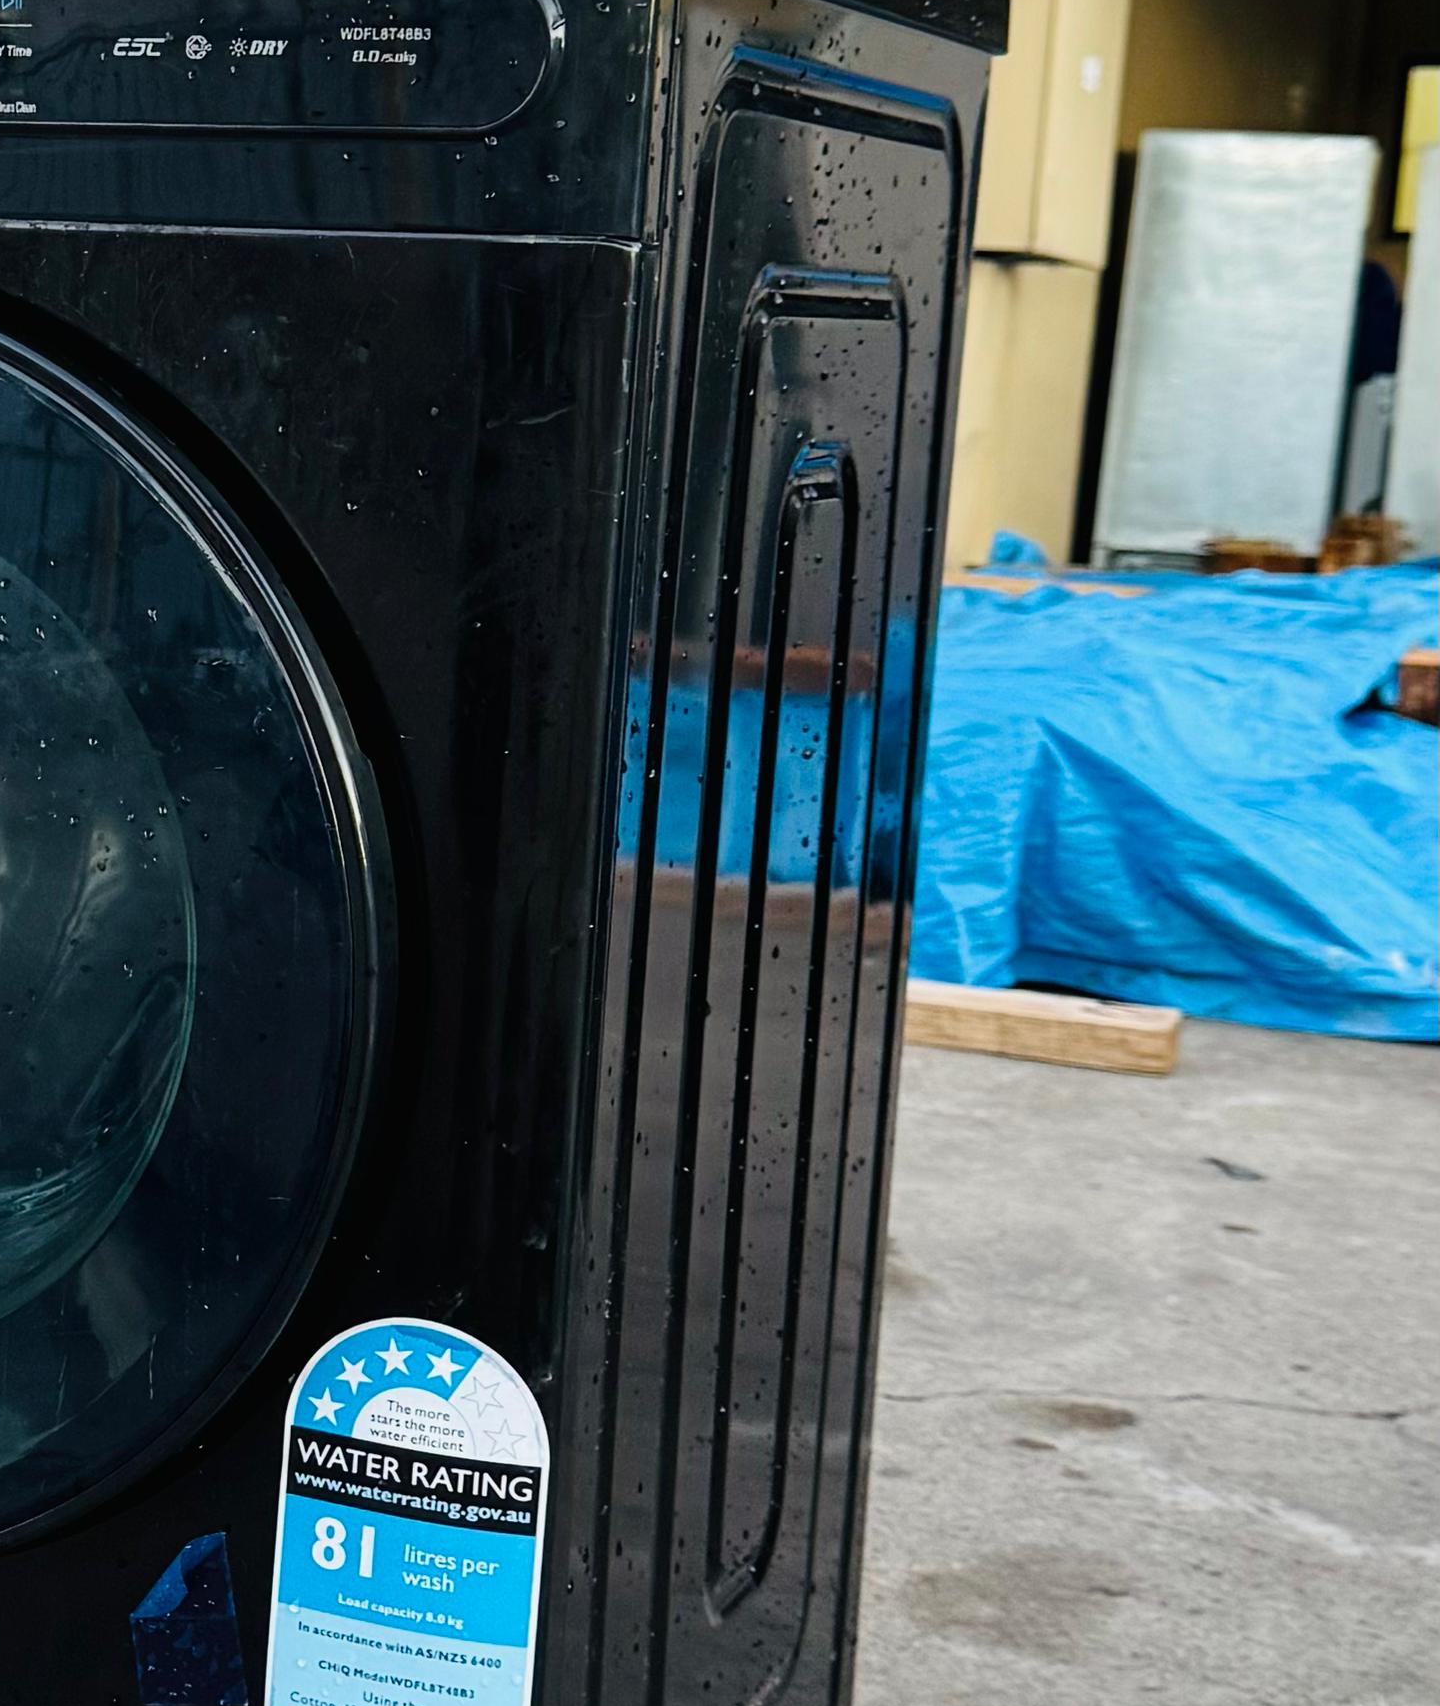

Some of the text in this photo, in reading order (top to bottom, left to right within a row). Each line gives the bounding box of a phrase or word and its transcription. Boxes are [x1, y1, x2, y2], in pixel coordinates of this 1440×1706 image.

[340, 27, 431, 41] WDFL8T48B3
[7, 44, 32, 57] Time
[249, 39, 288, 56] DRY
[387, 1399, 450, 1422] The more
[370, 1414, 466, 1439] stars the more
[370, 1427, 464, 1453] water efficient
[297, 1437, 534, 1502] WATER RATING
[294, 1471, 531, 1524] www.waterrating.gov.au
[311, 1516, 376, 1578] 81
[403, 1543, 500, 1578] litres per
[402, 1570, 455, 1593] wash
[338, 1592, 368, 1609] Load
[371, 1602, 423, 1623] capacity
[446, 1615, 465, 1630] kg
[298, 1621, 502, 1669] In accordance with AS/NZS 6400
[353, 1667, 389, 1684] Model
